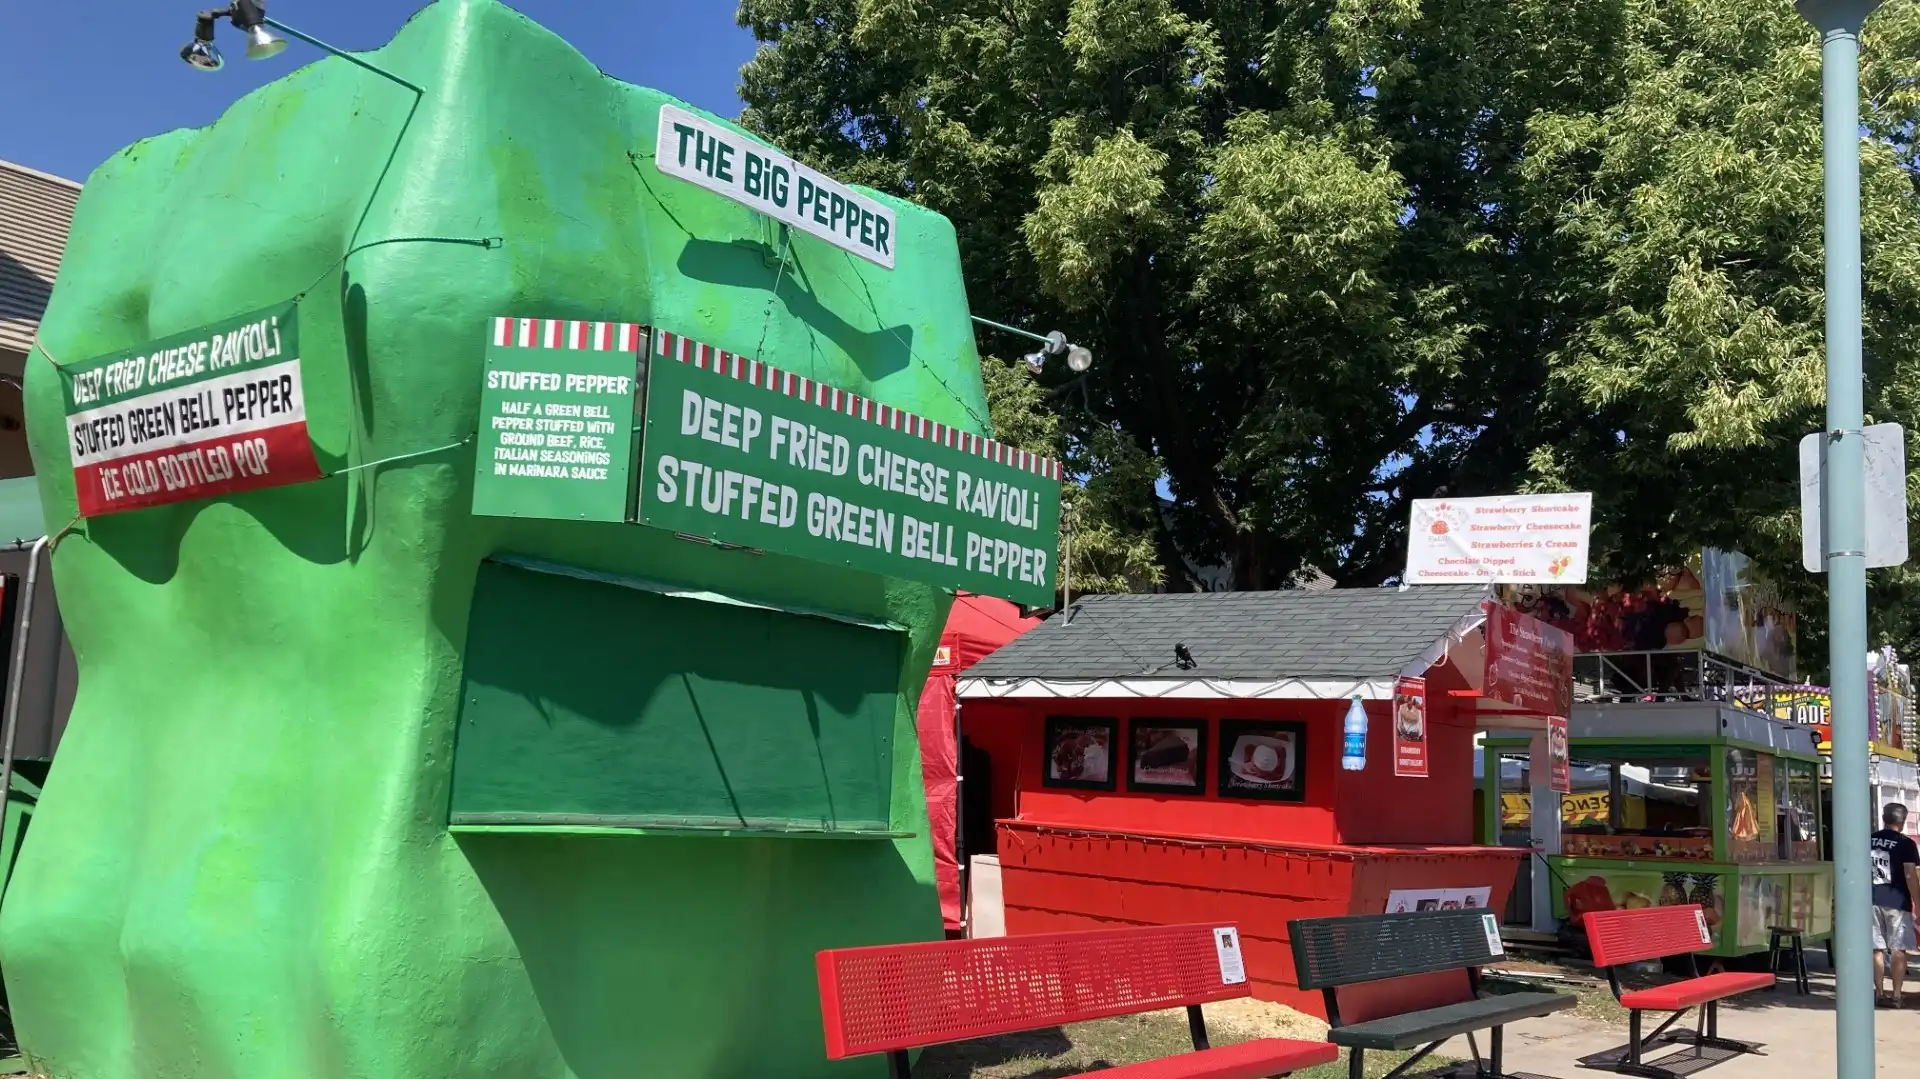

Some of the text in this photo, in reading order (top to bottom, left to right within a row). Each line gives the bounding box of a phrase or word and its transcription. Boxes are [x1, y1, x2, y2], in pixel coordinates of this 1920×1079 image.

[674, 122, 735, 183] THE
[797, 175, 890, 256] PEPPER
[73, 367, 103, 406] DEEP
[148, 340, 207, 387] CHEESE
[487, 370, 631, 395] STUFFED PEPPER
[74, 374, 293, 457] STUFFED GREEN BELL PEPPER
[501, 401, 611, 419] HALF A GREEN BELL
[492, 416, 533, 430] PEPPER
[535, 418, 584, 433] STUFFED
[500, 431, 544, 446] GROUND
[547, 434, 578, 449] BEEF,
[680, 388, 762, 454] DEEP
[857, 443, 950, 506] CHEESE
[123, 459, 160, 498] COLD
[160, 446, 230, 492] BOTTLED
[233, 437, 269, 478] POP
[571, 466, 608, 480] SAUCE
[1475, 504, 1580, 514] Strawberry Shortcake
[656, 454, 1048, 589] STUFFED GREEN BELL PEPPER
[1470, 522, 1582, 532] Strawberry Cheesecake
[1471, 540, 1578, 549] Strawberries & Cream
[1438, 557, 1515, 566] Chocolate Dipped
[1418, 569, 1469, 577] Cheesecake
[1476, 568, 1489, 577] On
[1512, 569, 1536, 577] Stick
[1871, 838, 1898, 849] TAFF
